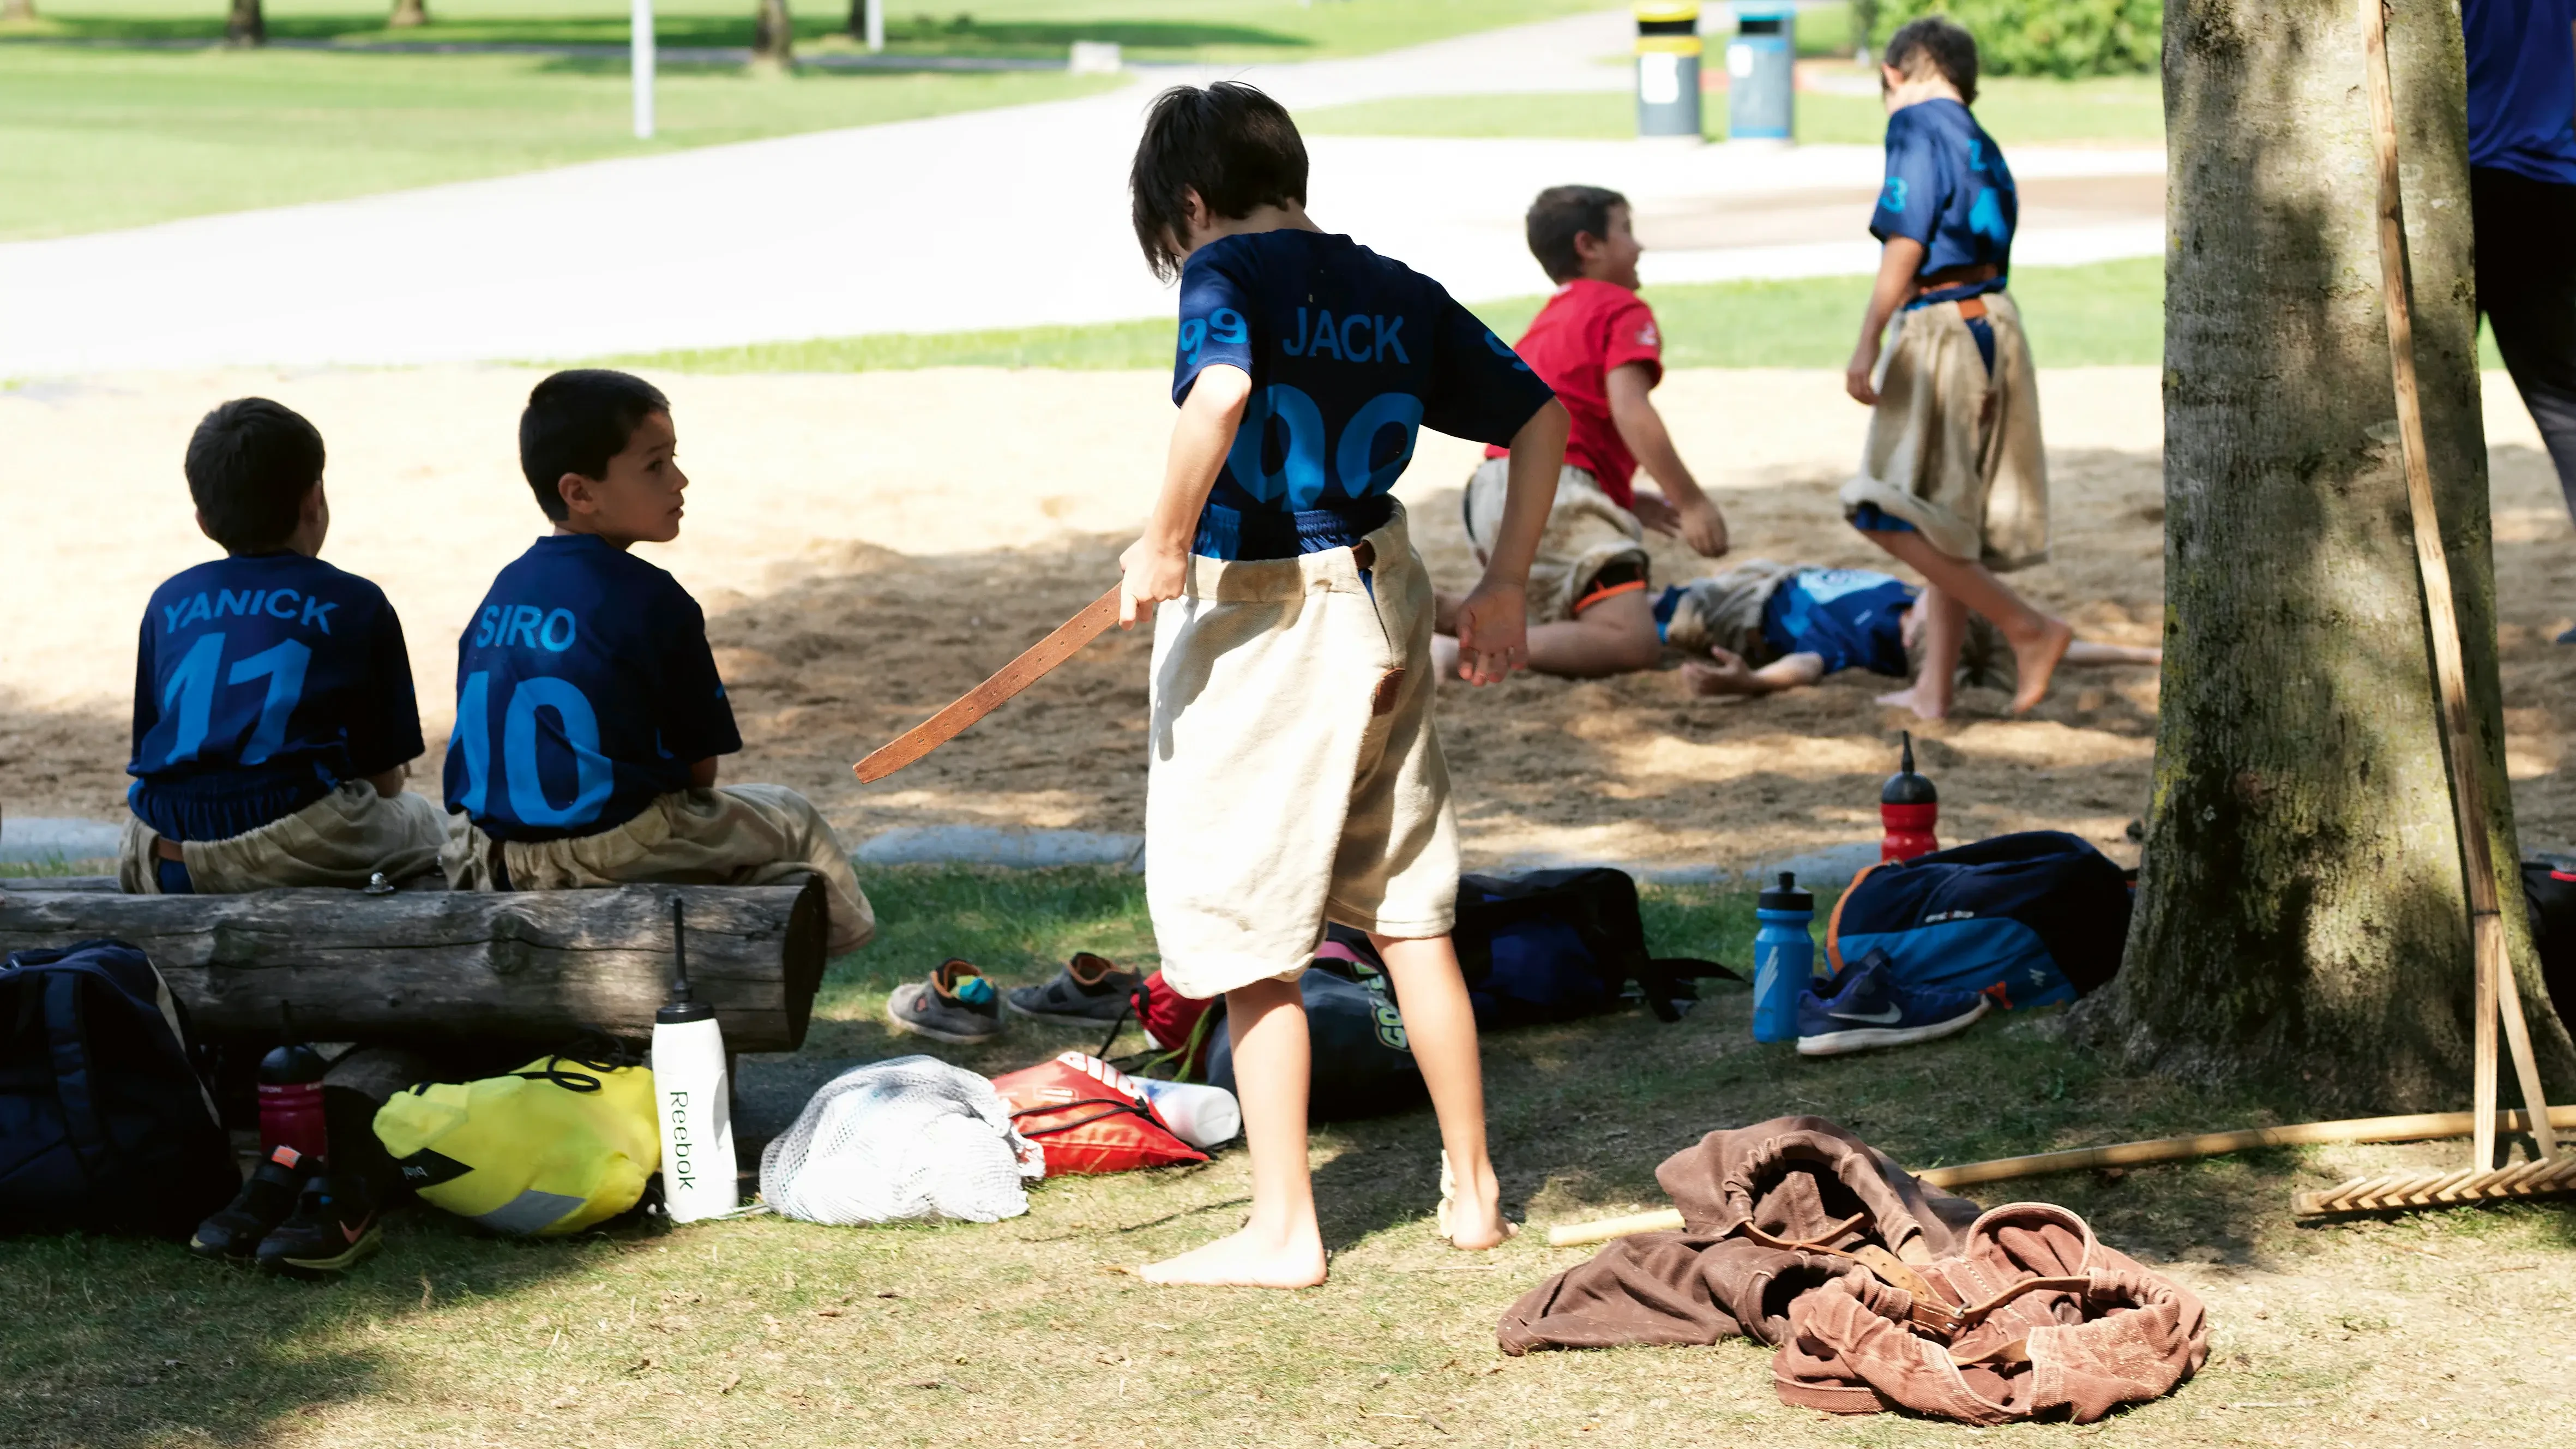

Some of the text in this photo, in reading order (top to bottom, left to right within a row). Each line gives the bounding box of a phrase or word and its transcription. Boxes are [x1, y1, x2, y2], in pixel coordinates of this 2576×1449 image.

[1179, 306, 1248, 365] 99
[1283, 306, 1410, 364] JACK
[162, 587, 339, 636] YANICK
[476, 603, 576, 653] SIRO
[446, 670, 614, 828] 10
[669, 1090, 696, 1191] Reebok
